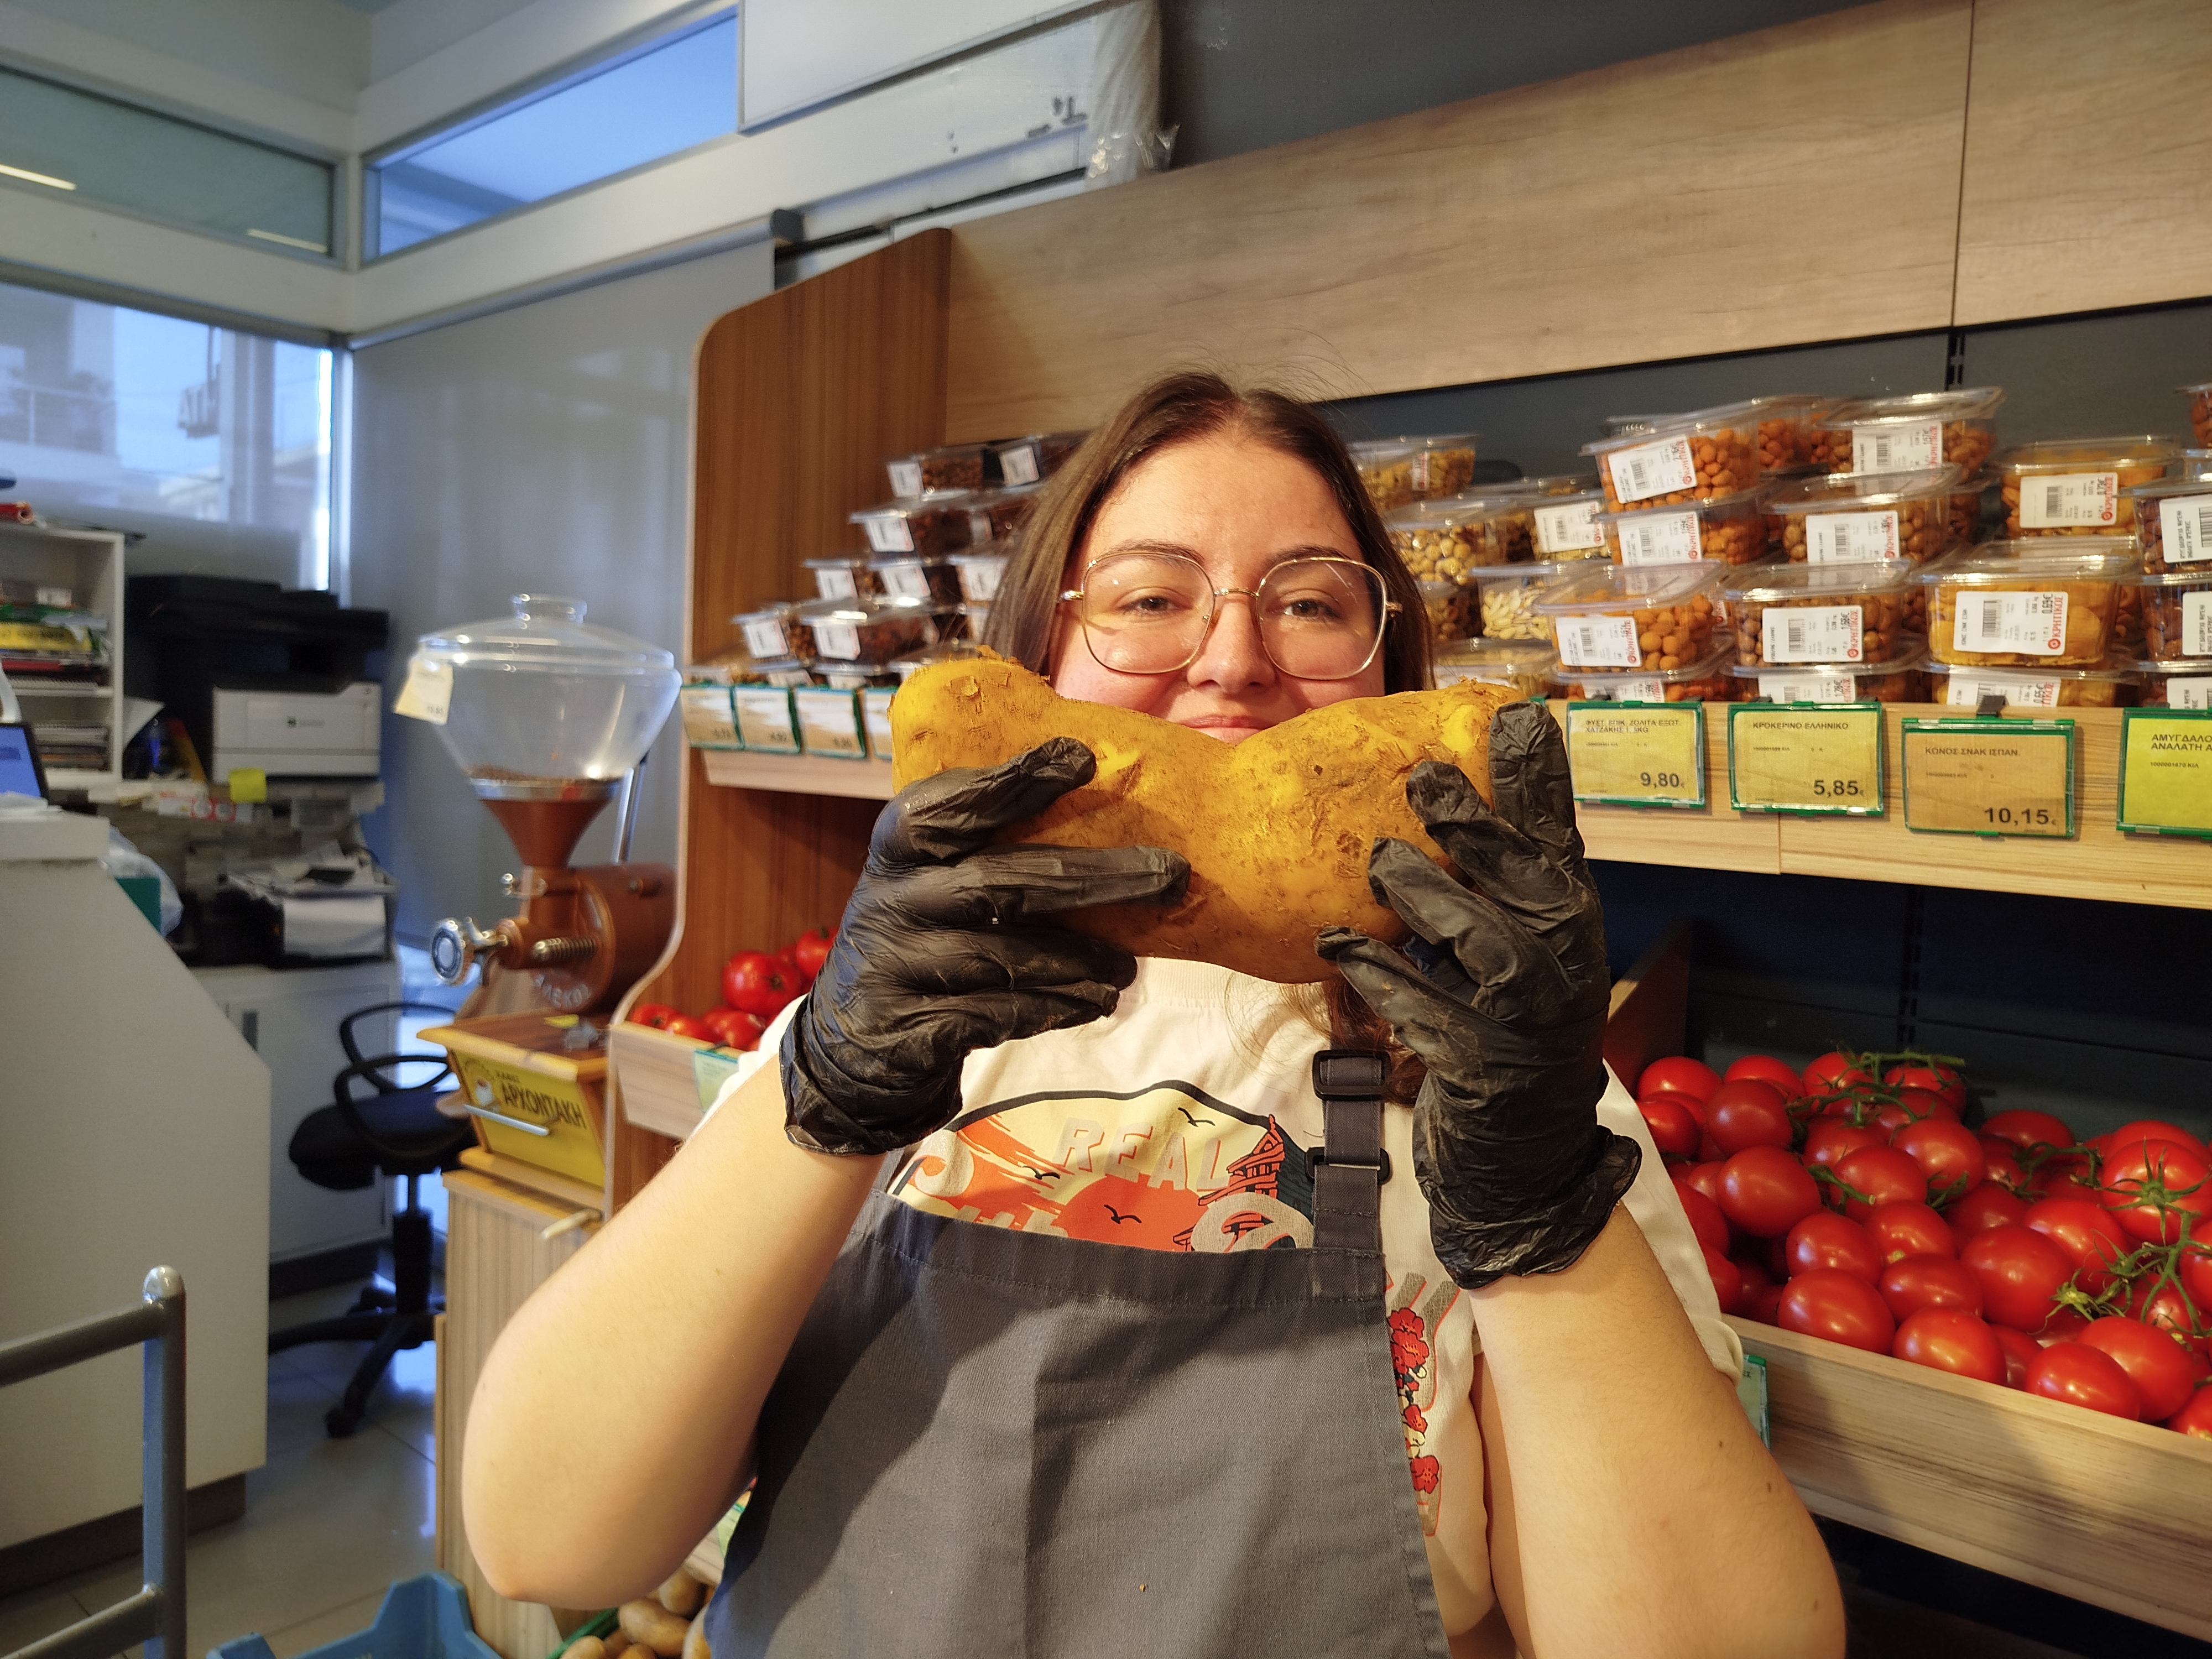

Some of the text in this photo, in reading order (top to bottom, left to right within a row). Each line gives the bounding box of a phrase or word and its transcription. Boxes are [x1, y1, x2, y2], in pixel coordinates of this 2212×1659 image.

[2053, 596, 2063, 638] ΚΡΗΤΙΚΟΣ
[1925, 747, 1958, 755] ΚΩΝΟΣ
[2151, 743, 2202, 752] ΑΝΑΛΑΤΗ
[502, 1081, 586, 1129] ΑΡΧΟΝΤΑΚΗ
[1052, 1117, 1231, 1192] REAL
